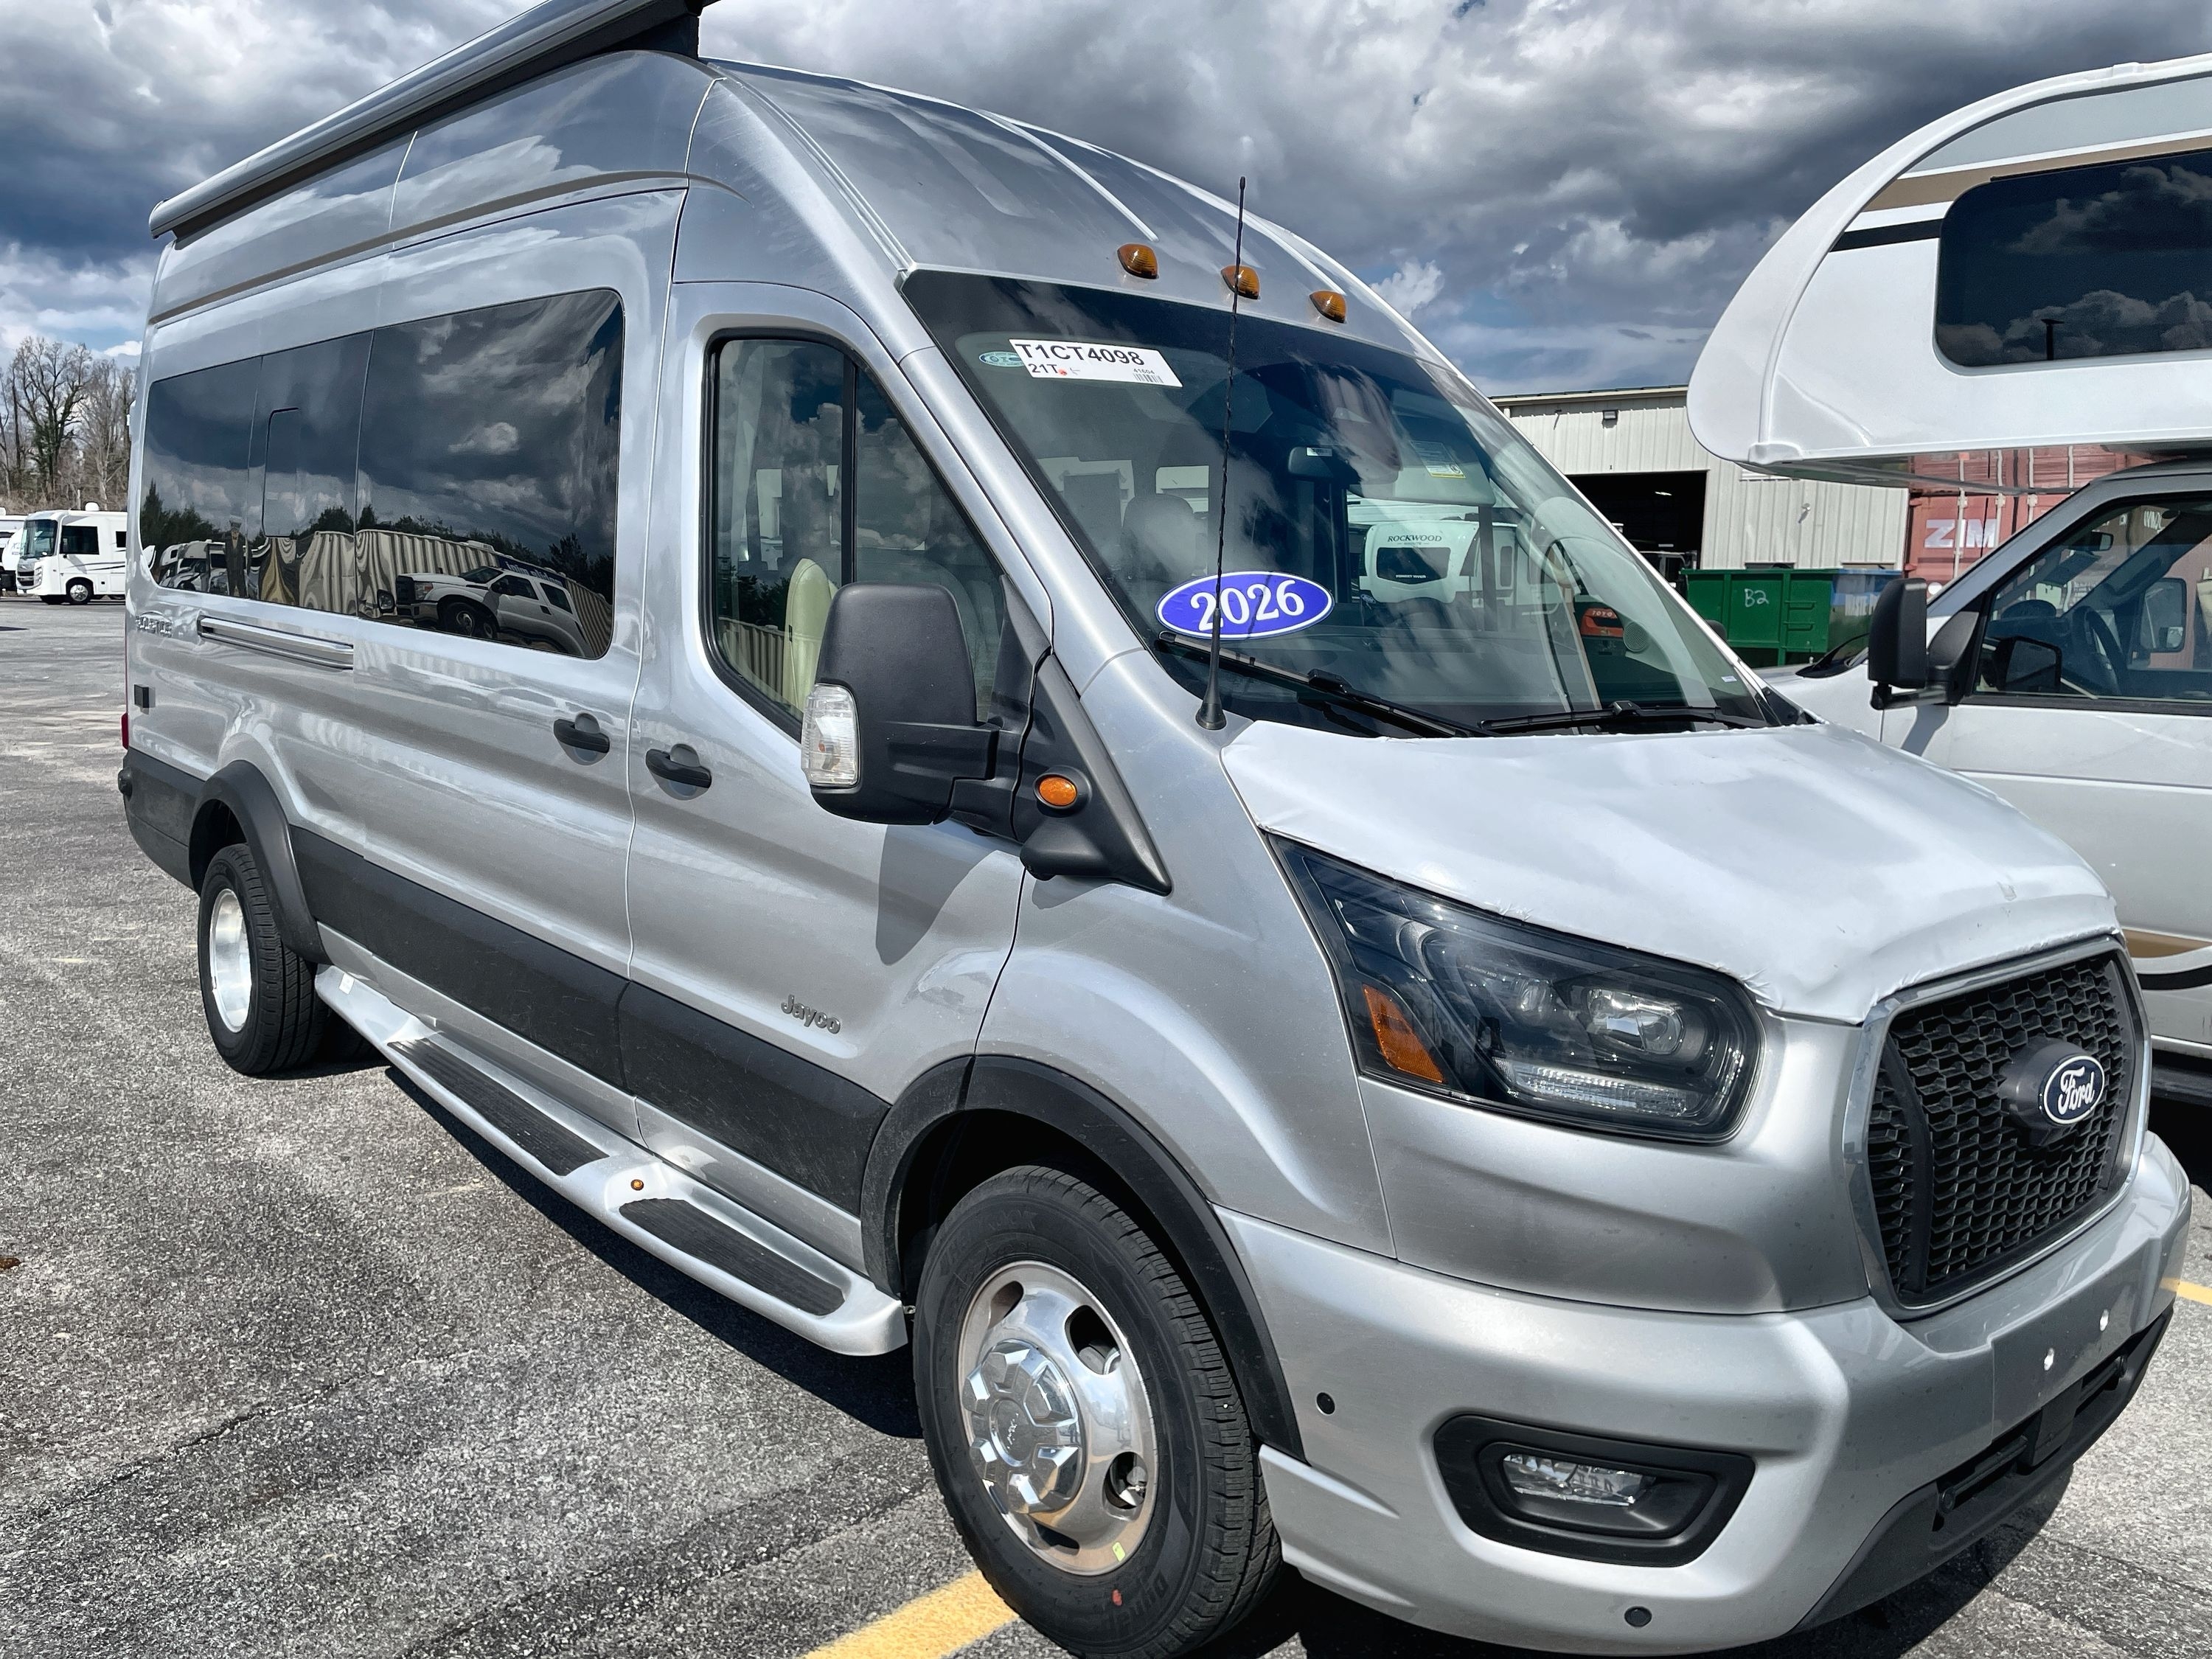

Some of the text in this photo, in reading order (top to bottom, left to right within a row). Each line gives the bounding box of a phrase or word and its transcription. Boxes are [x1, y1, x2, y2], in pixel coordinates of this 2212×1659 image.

[1015, 344, 1145, 366] T1CT4098
[1027, 364, 1057, 375] 21T
[1387, 535, 1442, 543] ROCKWOOD
[1924, 518, 1997, 548] ZIM
[1190, 580, 1305, 631] 2026
[1745, 588, 1769, 608] B2
[781, 994, 841, 1034] Jayco
[2057, 1066, 2095, 1115] Ford
